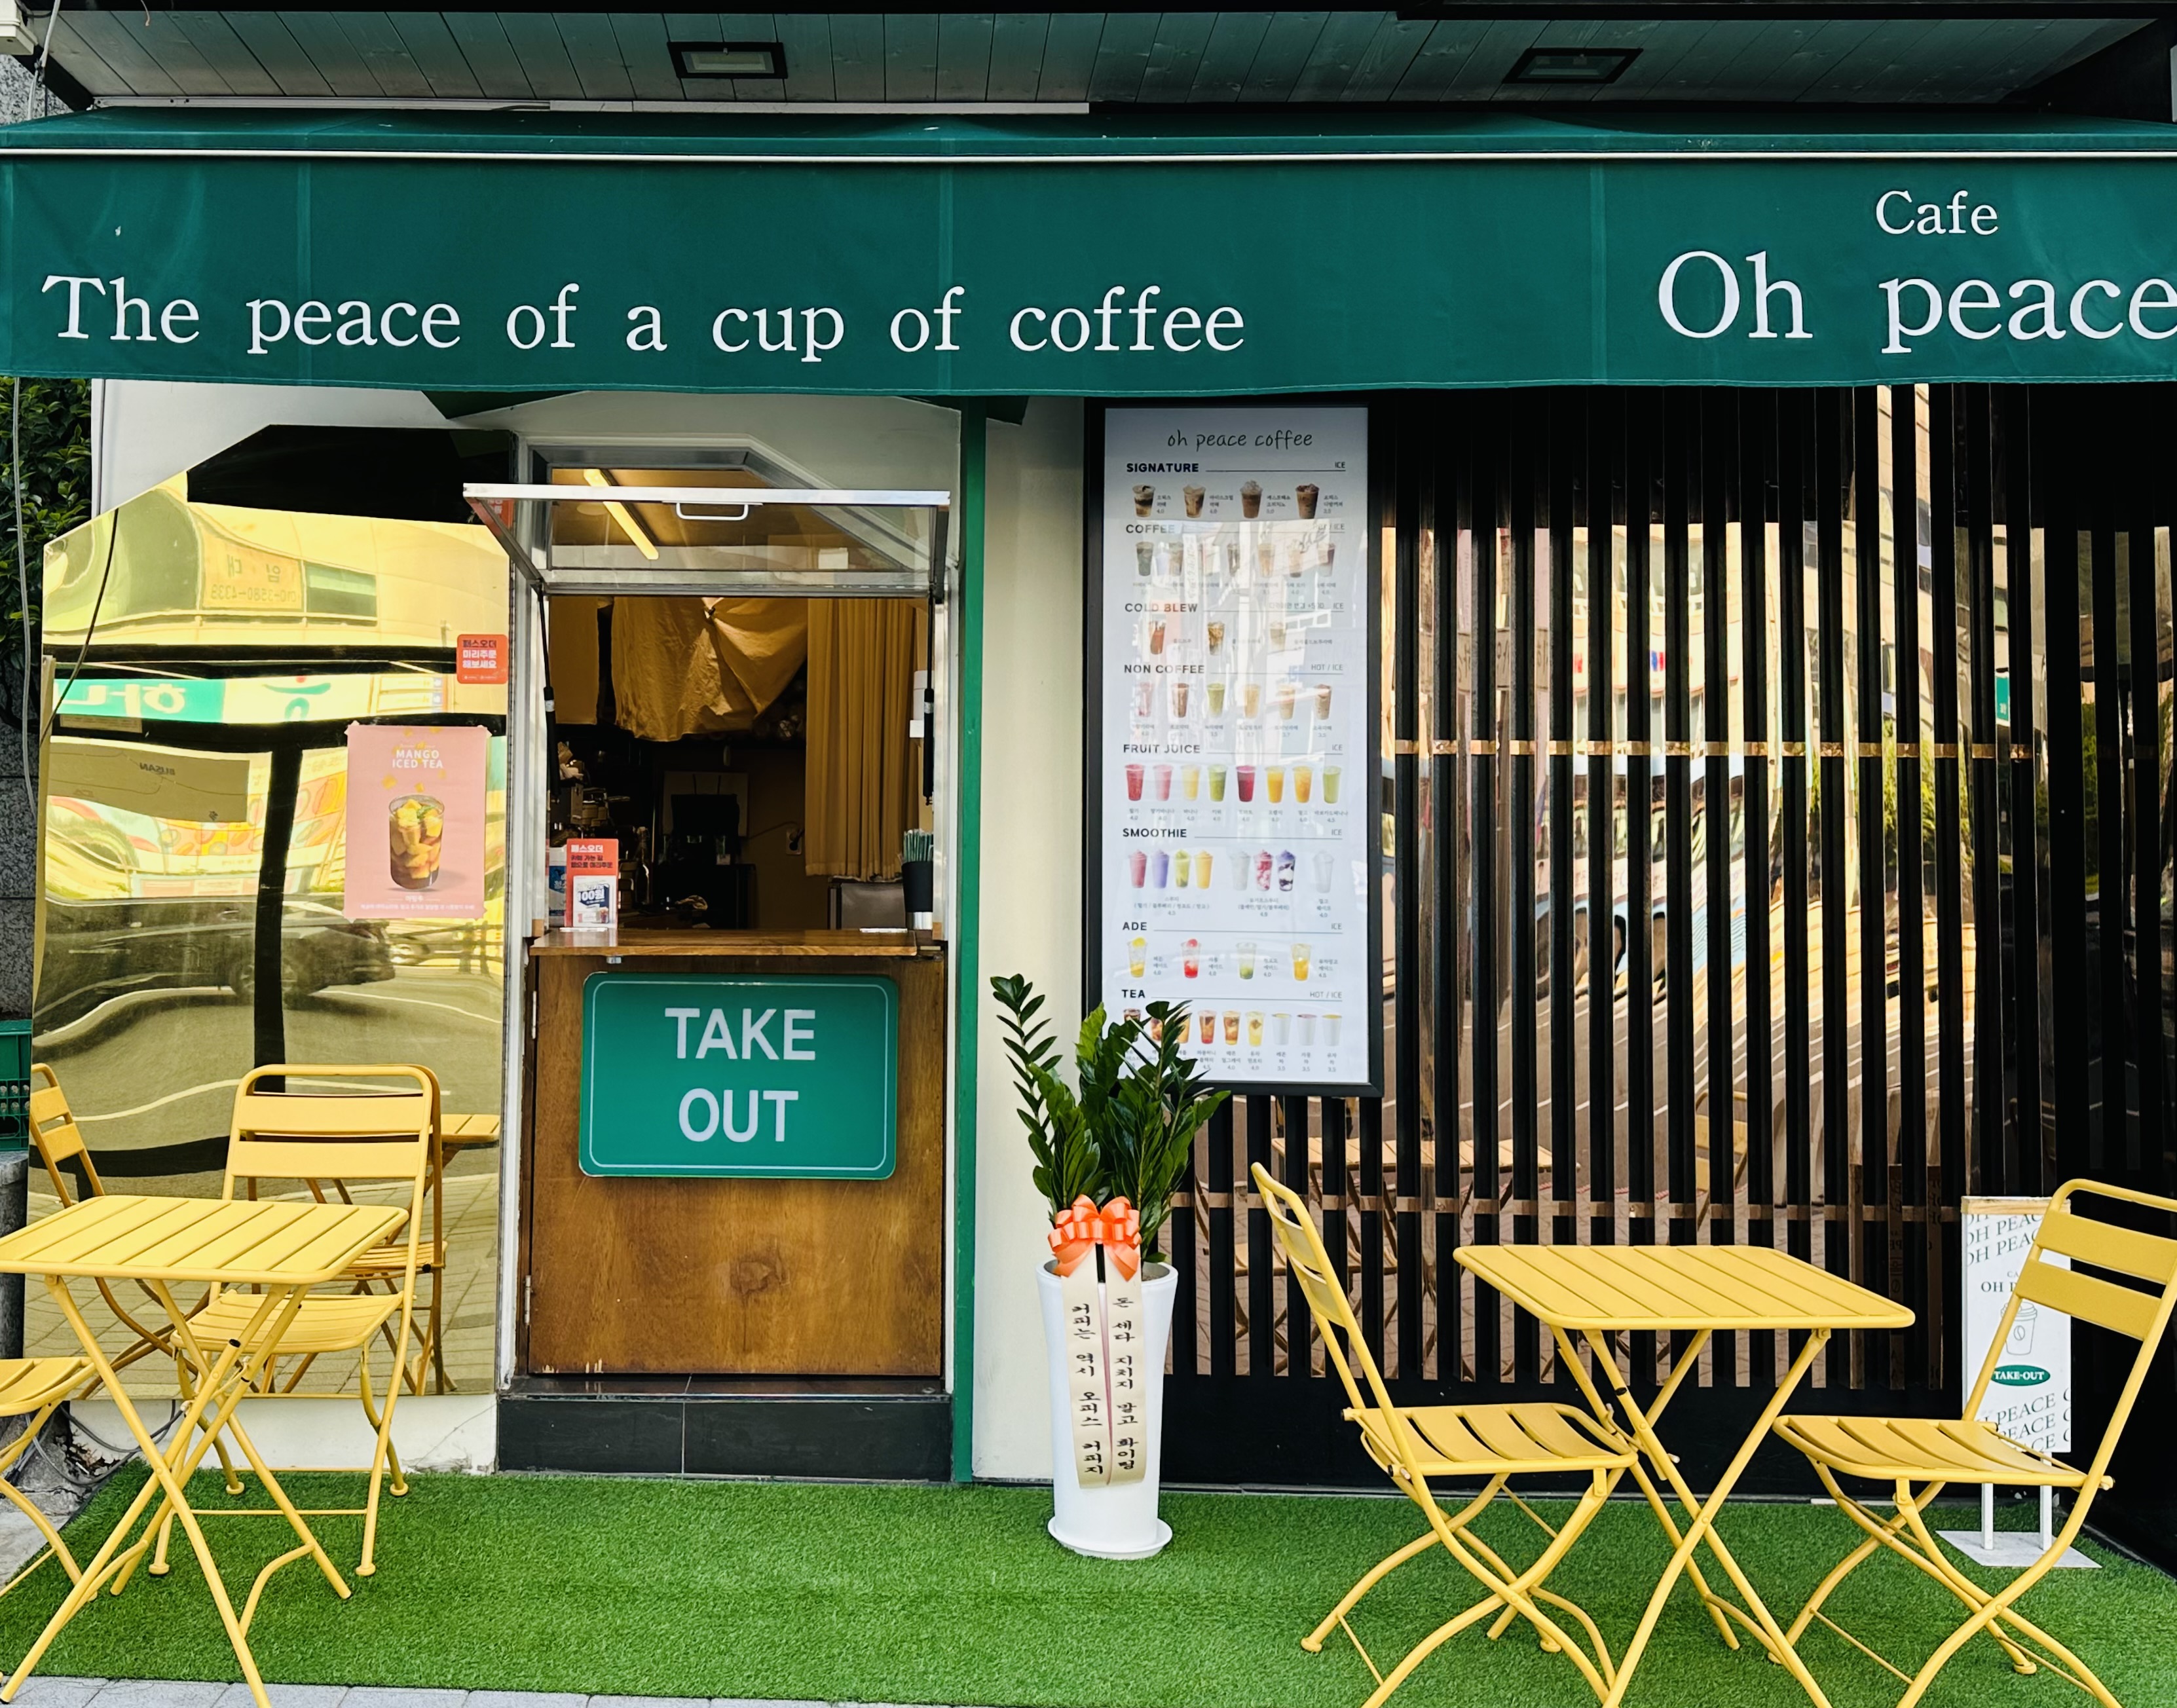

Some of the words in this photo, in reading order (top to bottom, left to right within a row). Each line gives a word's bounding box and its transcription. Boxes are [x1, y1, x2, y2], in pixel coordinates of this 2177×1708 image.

[1876, 190, 1999, 235] Cafe
[1658, 250, 1814, 339] Oh
[1878, 278, 2177, 354] peace
[41, 275, 200, 344] The
[246, 299, 460, 354] peace
[506, 283, 580, 350] of
[624, 303, 667, 351] a
[713, 306, 844, 362] cup
[890, 286, 965, 352] of
[1010, 285, 1244, 352] coffee
[1168, 430, 1187, 447] oh
[1196, 434, 1247, 452] peace
[1254, 429, 1312, 450] coffee
[1126, 462, 1199, 473] SIGNATURE
[1125, 524, 1176, 534] COFFEE
[1125, 603, 1159, 613] COLD
[1164, 603, 1198, 612] BLEW
[462, 639, 497, 648] 패스오더
[462, 649, 497, 659] 미리주문
[462, 659, 497, 669] 해보세요
[1124, 664, 1151, 673] NON
[1155, 665, 1204, 674] COFFEE
[396, 750, 439, 759] MANGO
[1123, 744, 1160, 753] FRUIT
[1164, 744, 1200, 754] JUICE
[392, 759, 418, 769] ICED
[421, 759, 443, 769] TEA
[1123, 828, 1187, 838] SMOOTHIE
[570, 844, 603, 853] 패스오더
[578, 888, 605, 902] 100원
[1123, 921, 1147, 931] ADE
[1121, 989, 1145, 999] TEA
[665, 1008, 816, 1061] TAKE
[679, 1088, 799, 1143] OUT
[1981, 1281, 2003, 1293] OH
[1112, 1297, 1134, 1309] 돈
[1071, 1303, 1096, 1339] 커피는
[1112, 1320, 1136, 1343] 세다
[1076, 1352, 1094, 1377] 역시
[1115, 1355, 1134, 1390] 지치지
[1994, 1371, 2045, 1381] TAKE-OUT
[1079, 1391, 1103, 1427] 오피스
[1116, 1402, 1138, 1426] 말고
[1996, 1393, 2056, 1426] PEACE
[1082, 1440, 1104, 1476] 커피지
